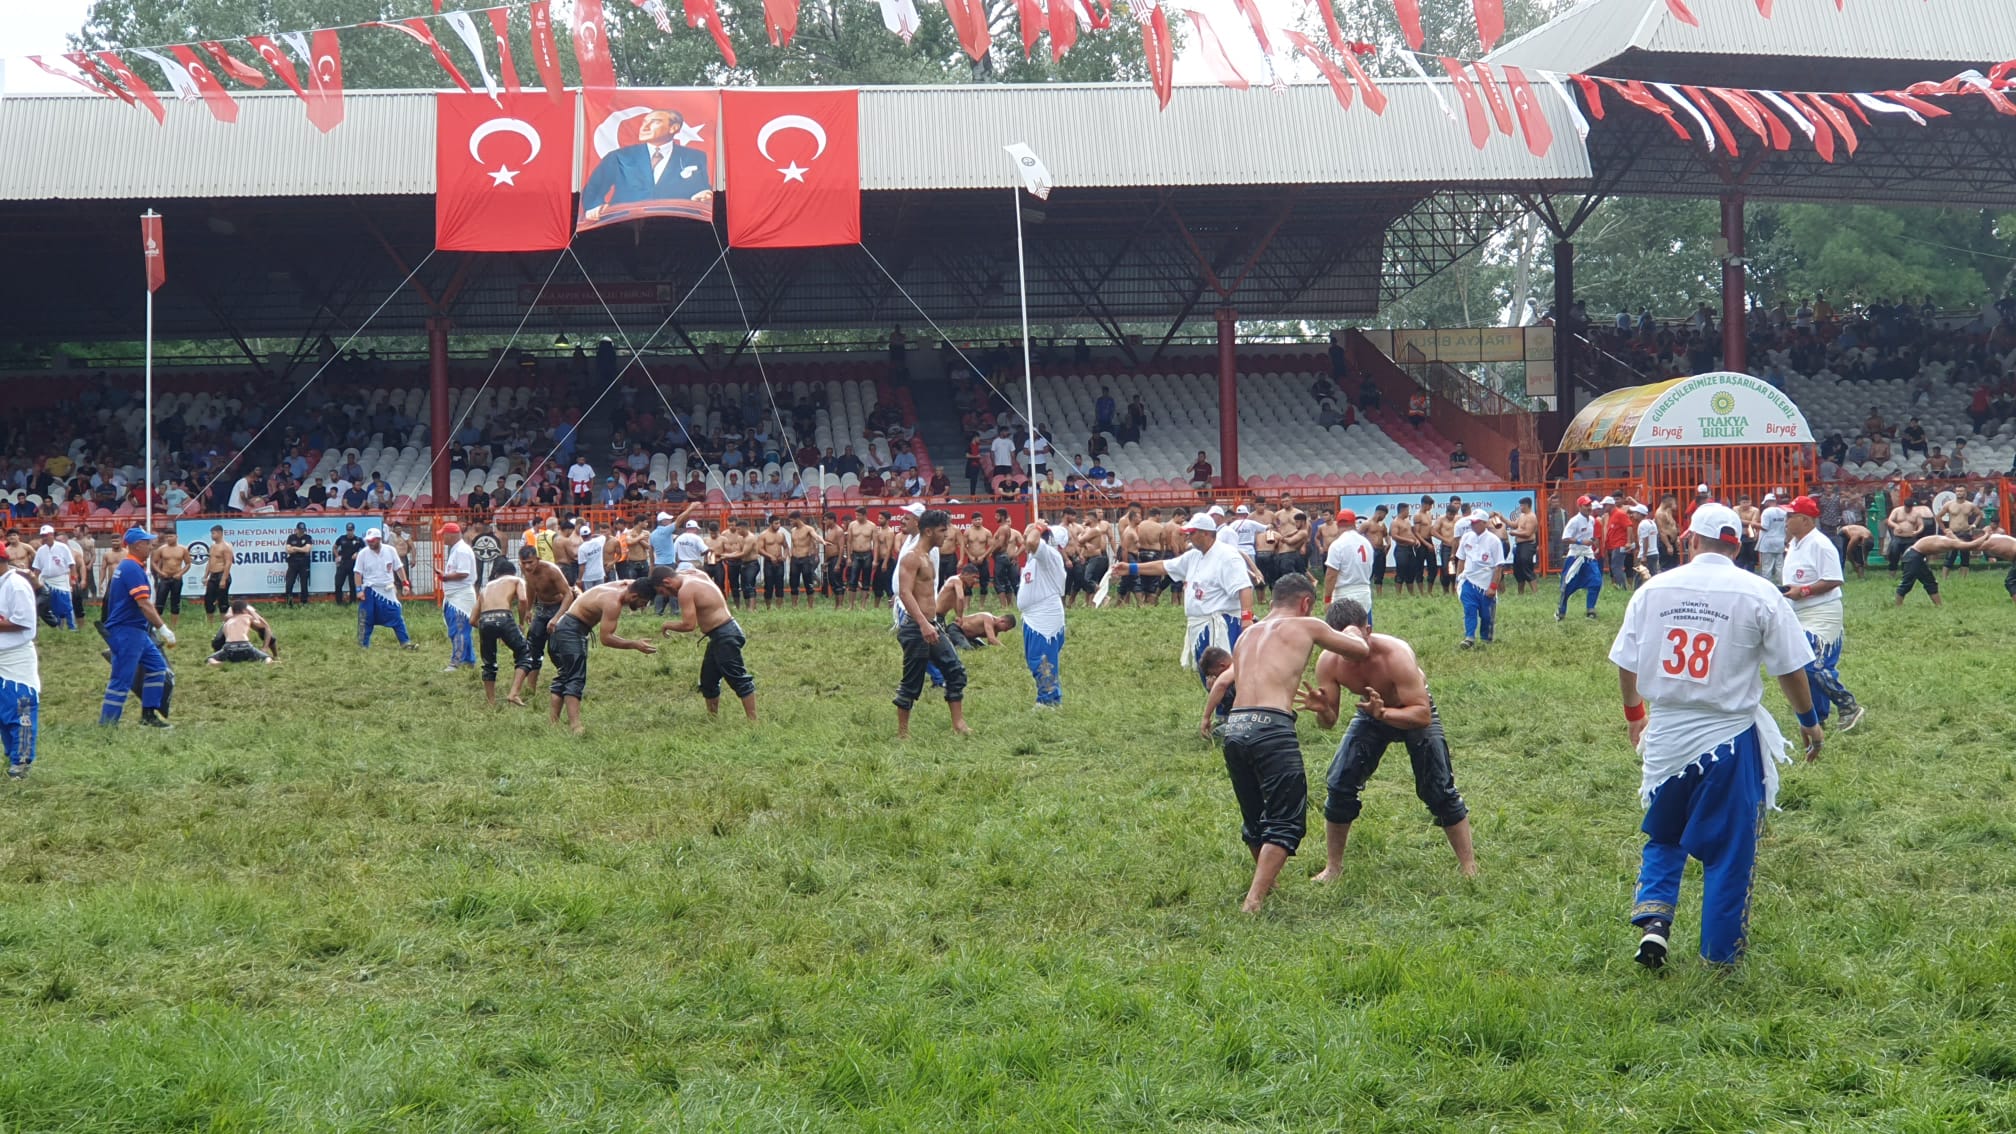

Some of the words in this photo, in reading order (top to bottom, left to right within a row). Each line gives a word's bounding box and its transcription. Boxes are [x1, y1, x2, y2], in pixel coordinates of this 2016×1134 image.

[1652, 375, 1718, 423] GÜREŞÇİLERİMİZE
[1719, 375, 1768, 396] BAŞARILAR
[1767, 391, 1796, 419] DİLERİZ
[1697, 416, 1749, 427] TRAKYA
[1651, 425, 1684, 440] Biryağ
[1766, 423, 1797, 437] Biryağ
[237, 528, 277, 536] MEYDANI
[1357, 544, 1367, 563] 1
[1681, 600, 1709, 608] TÜRKİYE
[1659, 607, 1698, 618] GELENEKSEL
[1698, 608, 1730, 621] GÜREŞLER
[1673, 615, 1715, 623] FEDERASYONU
[1662, 628, 1715, 679] 38
[1251, 713, 1272, 724] BLD
